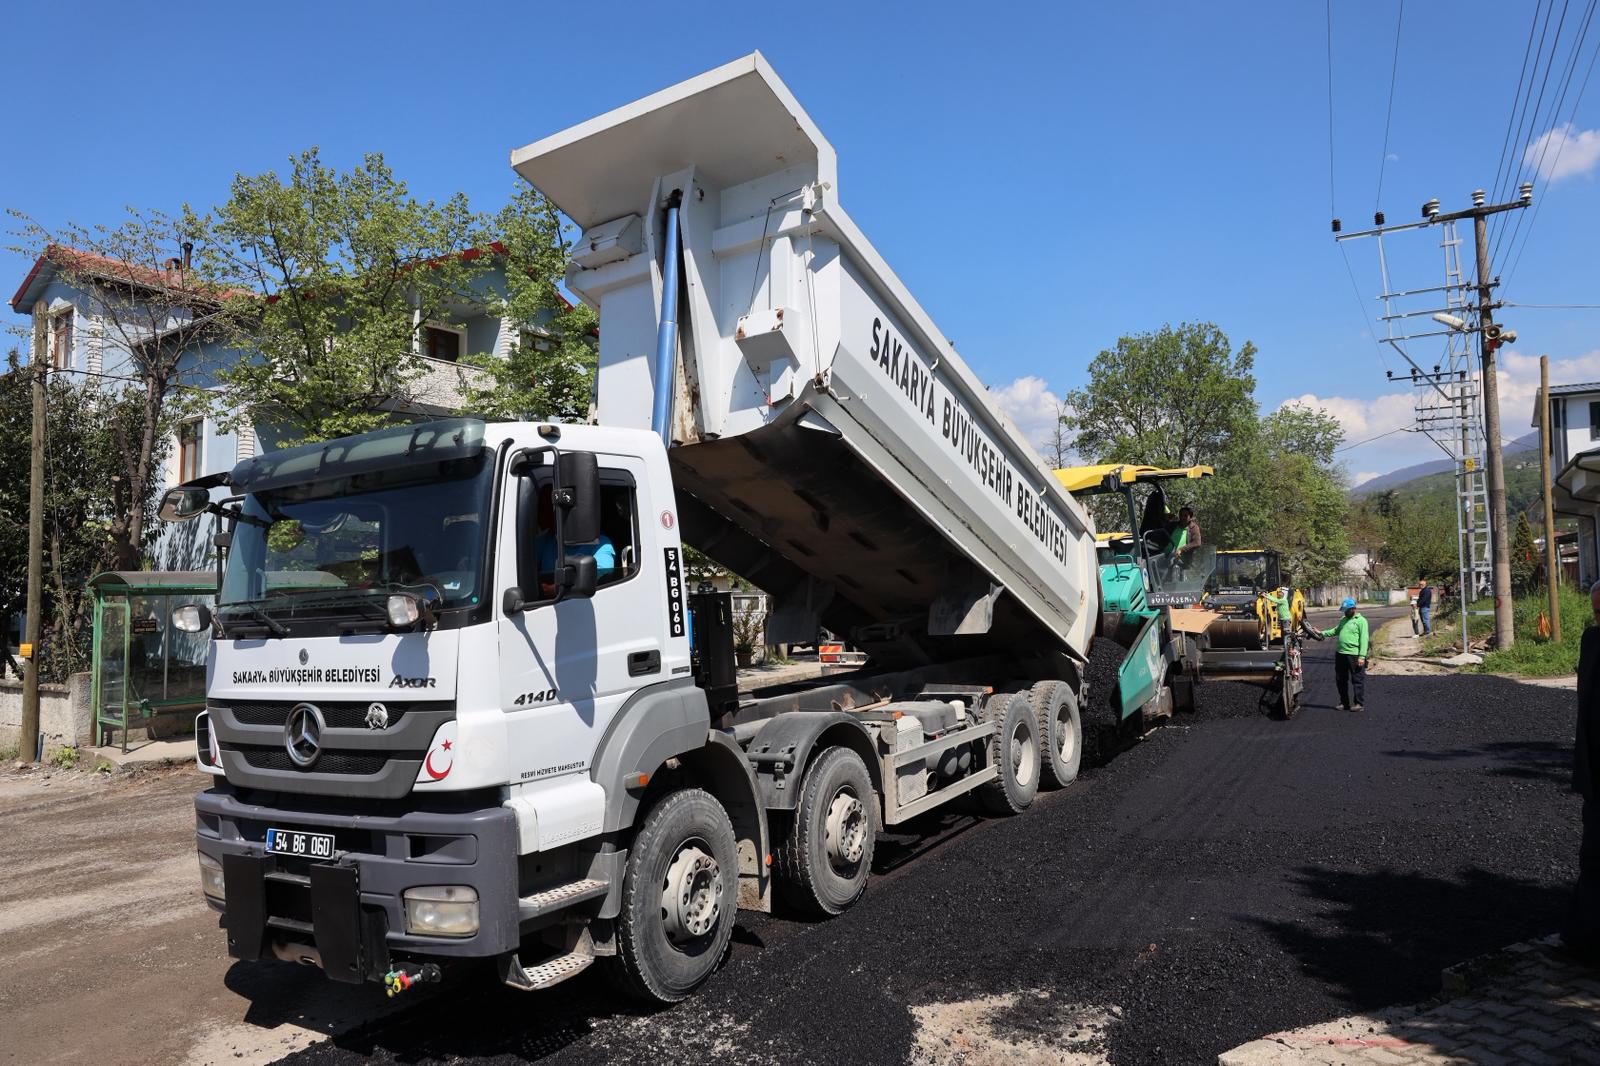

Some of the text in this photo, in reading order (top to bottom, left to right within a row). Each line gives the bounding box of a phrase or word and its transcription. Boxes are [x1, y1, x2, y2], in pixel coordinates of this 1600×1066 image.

[869, 316, 1069, 566] SAKARYA BÜYÜKŞEHİR BELEDİYESİ
[665, 512, 671, 527] 1
[667, 550, 682, 633] 54 BG 060
[232, 665, 380, 686] SAKARYA BÜYÜKŞEHİR BELEDİYESİ
[514, 688, 557, 706] 4140
[275, 832, 330, 857] 54 BG 060
